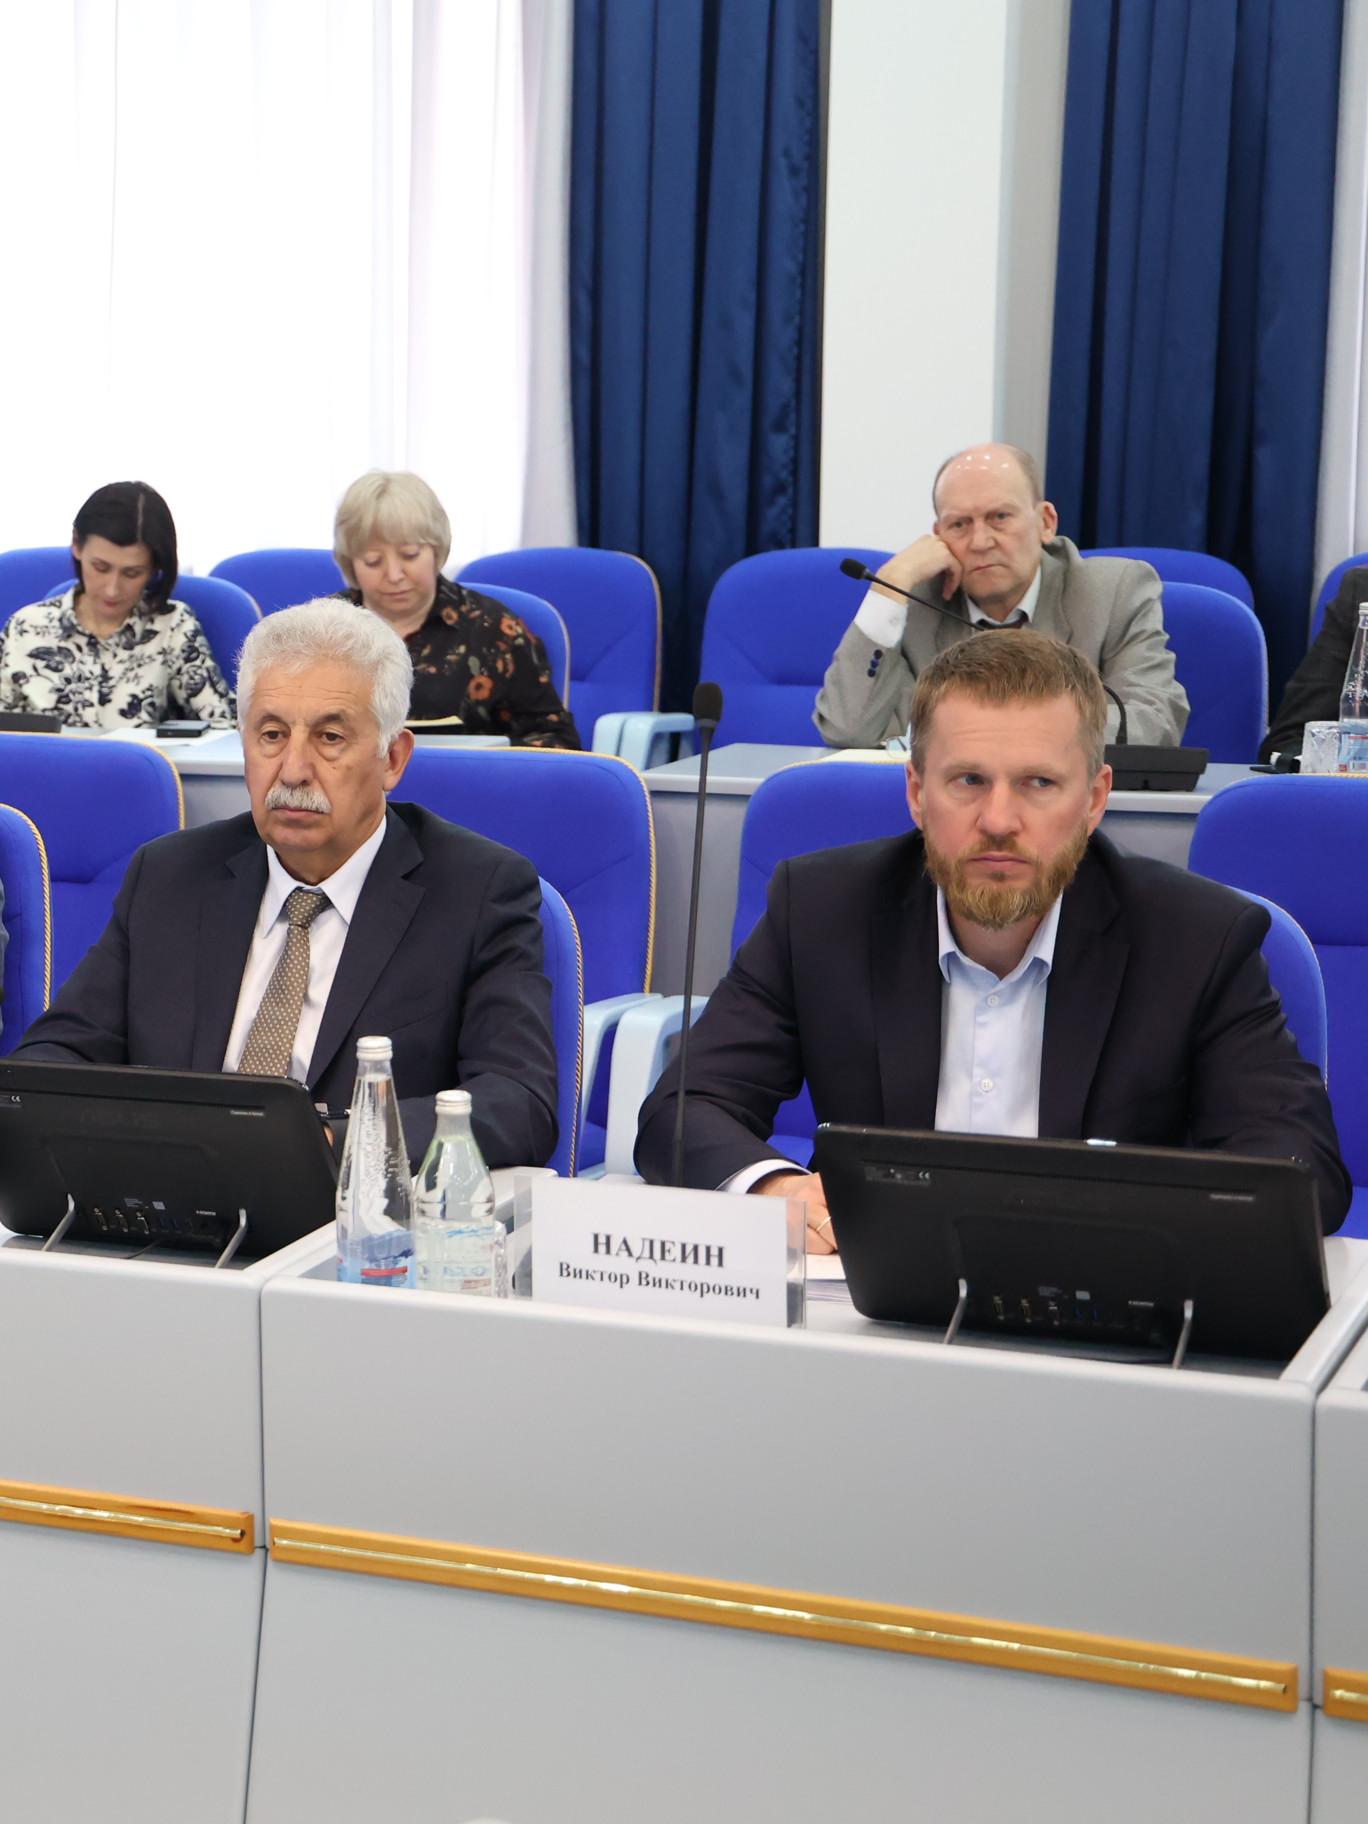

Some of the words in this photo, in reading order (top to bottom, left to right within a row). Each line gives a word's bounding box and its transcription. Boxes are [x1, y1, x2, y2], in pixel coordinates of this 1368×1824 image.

[592, 1232, 726, 1268] НАДЕИН
[558, 1261, 631, 1289] Виктор
[637, 1270, 761, 1300] Викторович
